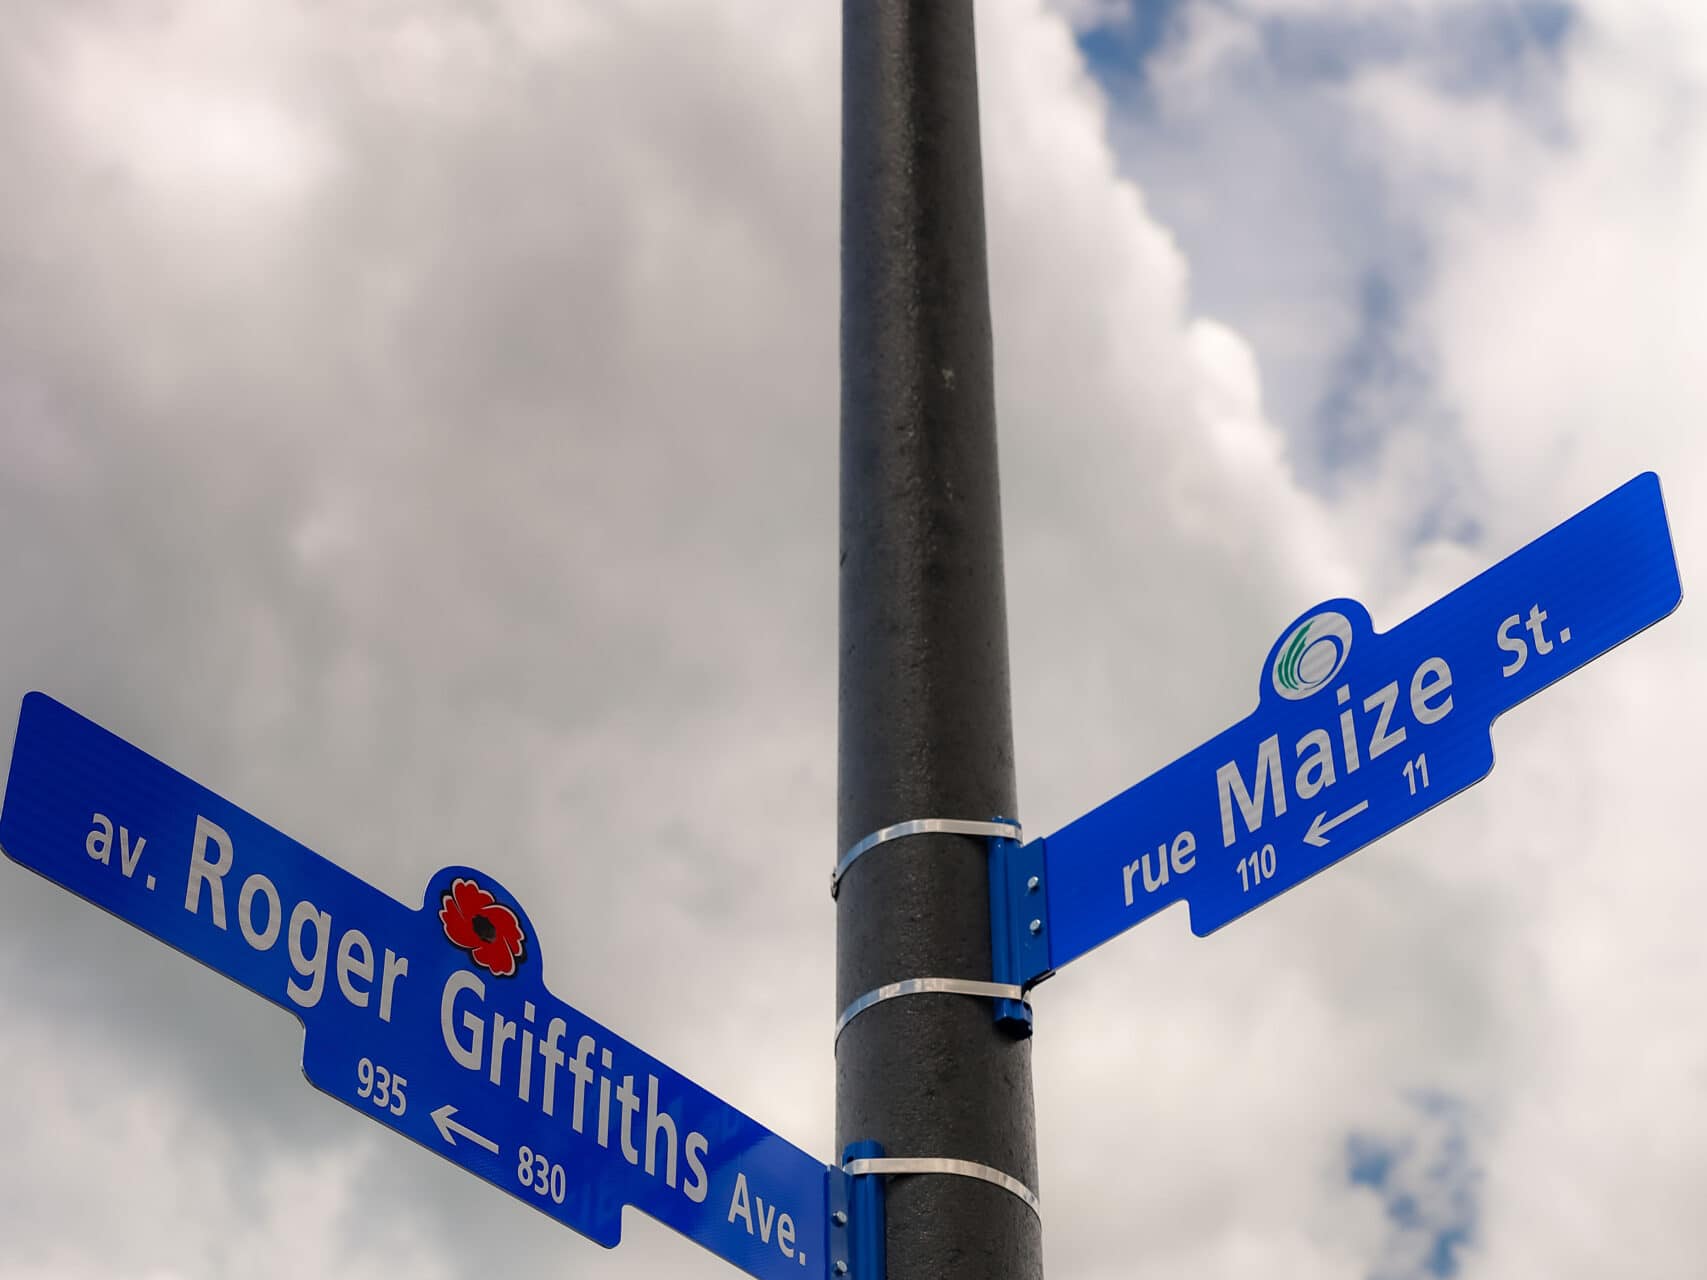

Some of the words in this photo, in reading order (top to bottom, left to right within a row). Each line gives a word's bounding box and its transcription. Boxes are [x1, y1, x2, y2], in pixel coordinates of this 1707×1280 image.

[1121, 831, 1196, 906] rue
[1216, 656, 1454, 848] Maize
[1496, 604, 1572, 678] St.
[1235, 844, 1277, 892] 110
[1402, 753, 1429, 796] 11
[86, 812, 156, 890] av.
[184, 814, 408, 1023] Roger
[440, 968, 709, 1204] Griffiths
[728, 1172, 806, 1266] Ave.
[357, 1057, 407, 1116] 935
[517, 1145, 567, 1205] 830
